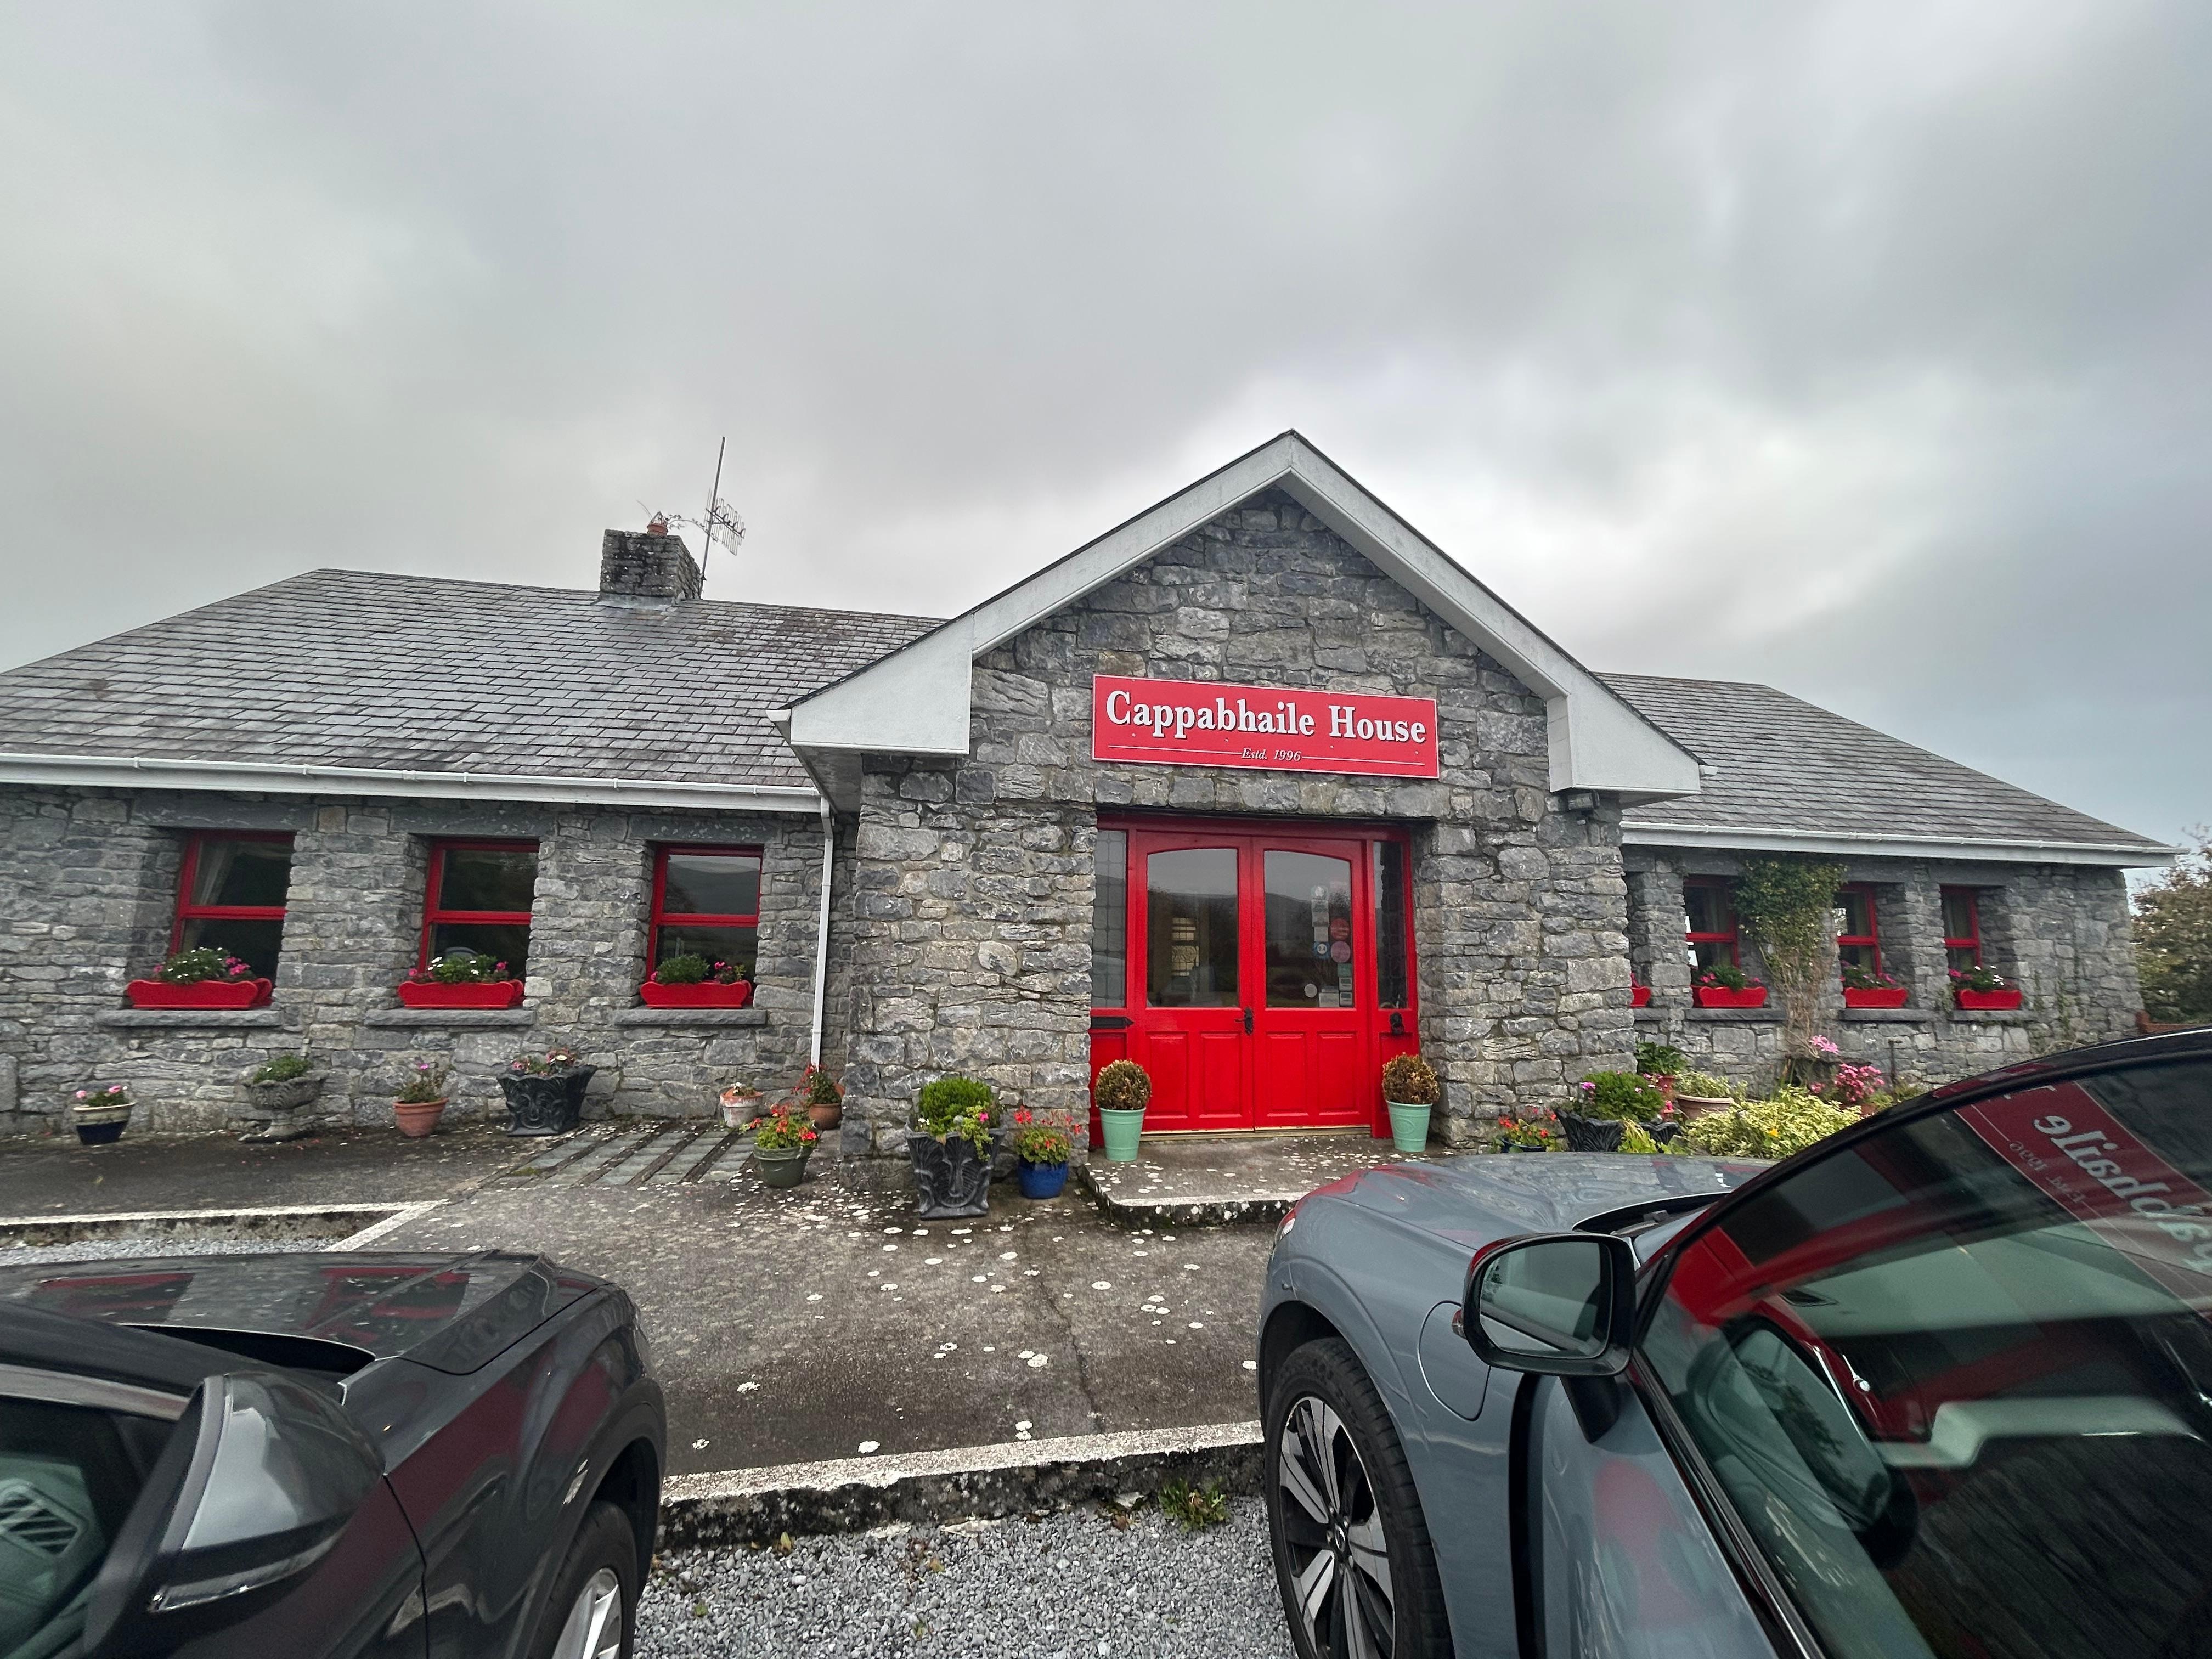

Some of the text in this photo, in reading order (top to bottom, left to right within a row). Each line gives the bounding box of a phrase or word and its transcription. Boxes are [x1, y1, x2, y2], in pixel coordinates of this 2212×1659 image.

[1106, 690, 1426, 743] Cappabhaile House
[1241, 748, 1301, 762] Estd. 1996
